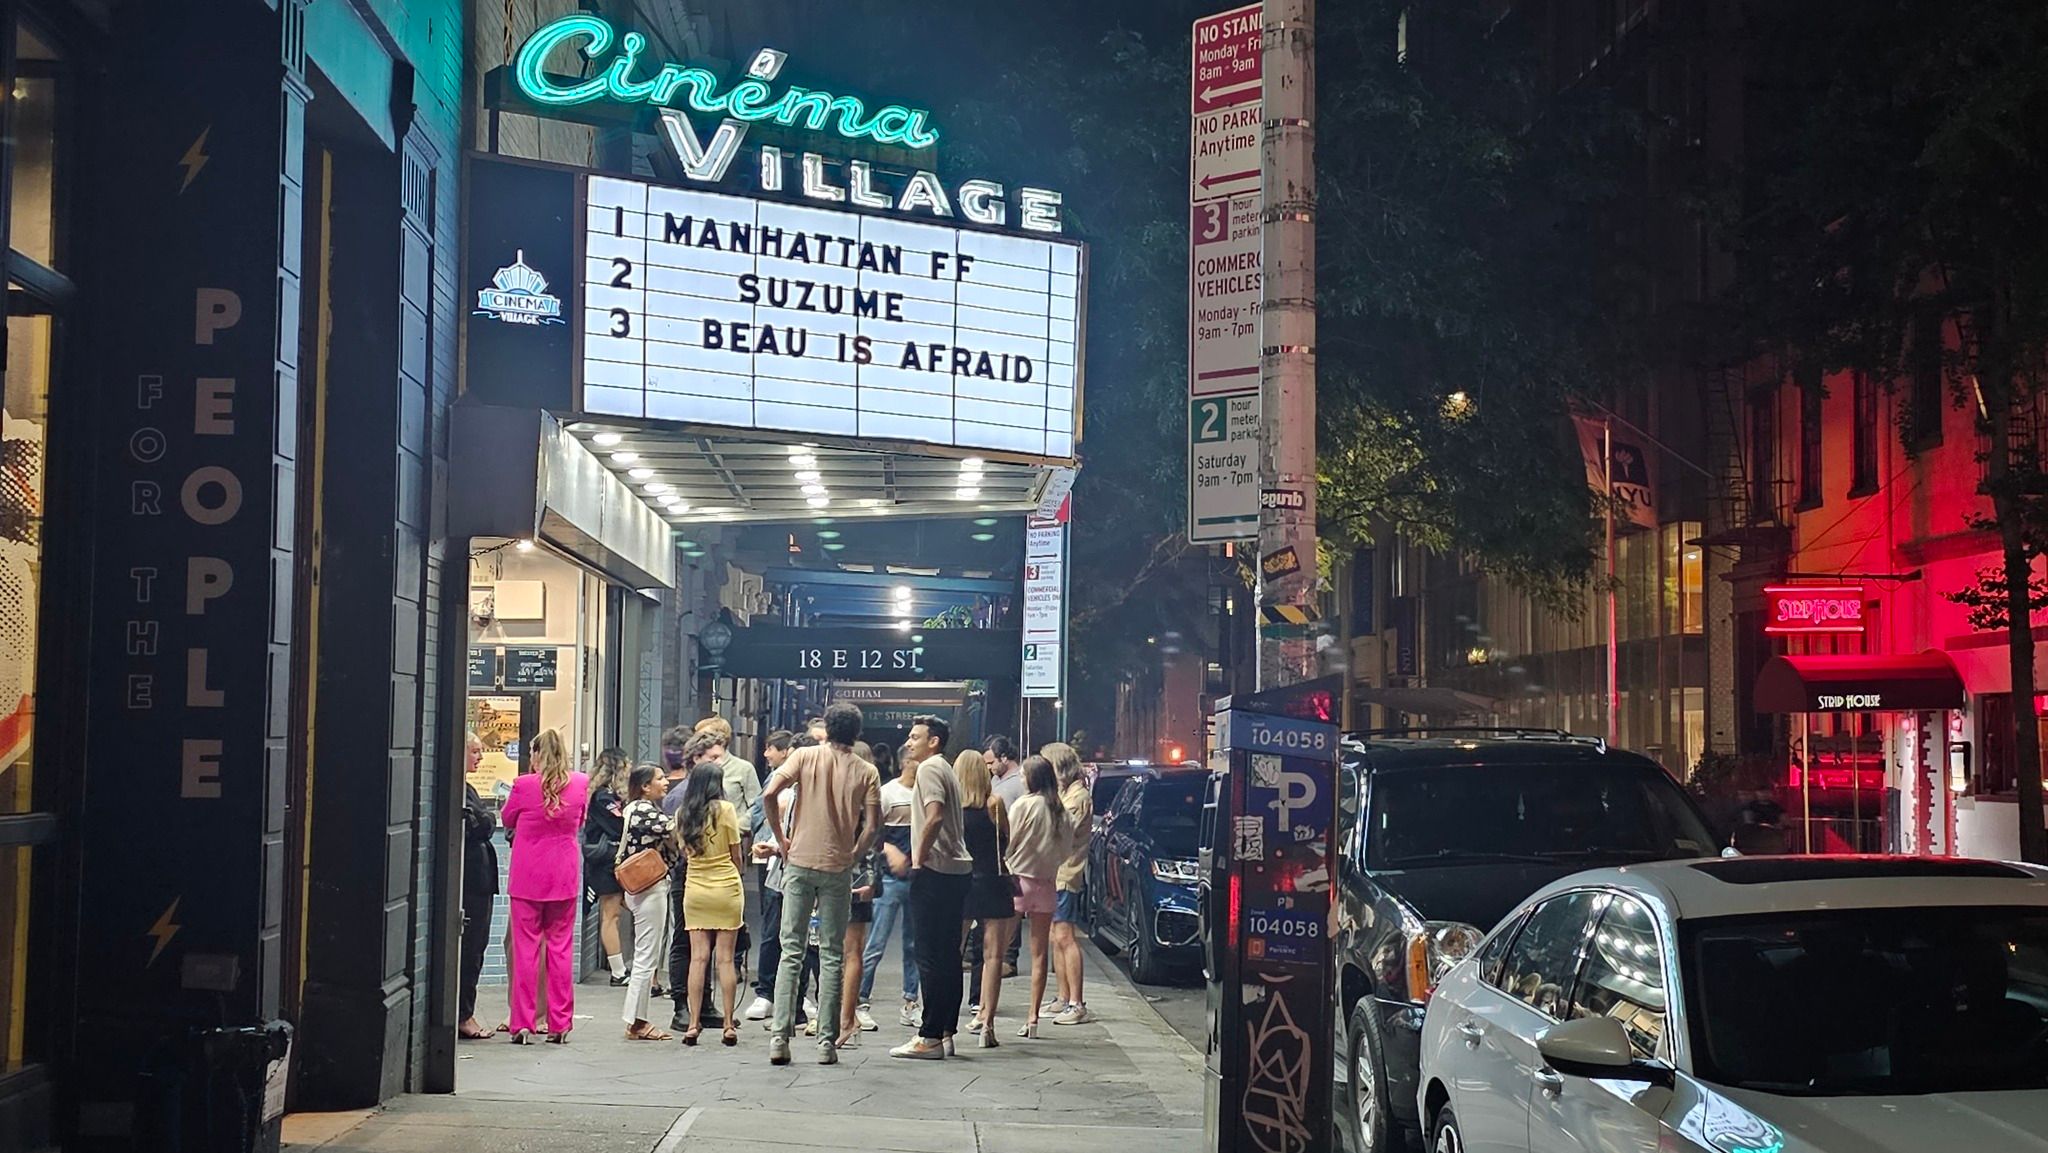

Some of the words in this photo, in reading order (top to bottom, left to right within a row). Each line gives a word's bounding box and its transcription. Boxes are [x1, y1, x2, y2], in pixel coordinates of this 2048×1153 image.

[1199, 25, 1218, 45] NO
[1199, 43, 1239, 64] Monday
[1199, 66, 1222, 81] 8am
[1232, 57, 1255, 73] 9am
[1199, 116, 1218, 135] NO
[1199, 134, 1256, 157] Anytime
[655, 107, 1063, 234] VILLAGE
[1202, 203, 1220, 240] 3
[1232, 199, 1252, 211] hour
[613, 206, 625, 239] 1
[663, 212, 902, 275] MANHATTAN
[930, 252, 974, 282] FF
[611, 258, 633, 290] 2
[739, 274, 904, 322] SUZUME
[1198, 273, 1261, 298] VEHICLES
[493, 295, 546, 311] CINEMA
[500, 311, 540, 325] VILLAGE
[1198, 305, 1239, 323] Monday
[1199, 325, 1221, 341] 9am
[1232, 322, 1255, 338] 7pm
[610, 308, 632, 339] 3
[703, 319, 807, 357] BEAU
[838, 334, 872, 365] IS
[900, 341, 1034, 384] AFRAID
[1201, 402, 1219, 440] 2
[1231, 400, 1251, 412] hour
[1198, 453, 1246, 470] Saturday
[1198, 474, 1219, 488] 9am
[1231, 471, 1253, 487] 7pm
[1029, 566, 1038, 579] 3
[799, 649, 822, 669] 18
[832, 649, 849, 669] E
[860, 649, 883, 669] 12
[892, 649, 922, 669] ST
[835, 689, 881, 698] GOTHAM
[1818, 696, 1845, 709] STRIP
[1846, 694, 1881, 709] HOUSE
[1251, 727, 1326, 750] 104058
[1249, 916, 1319, 939] 104058
